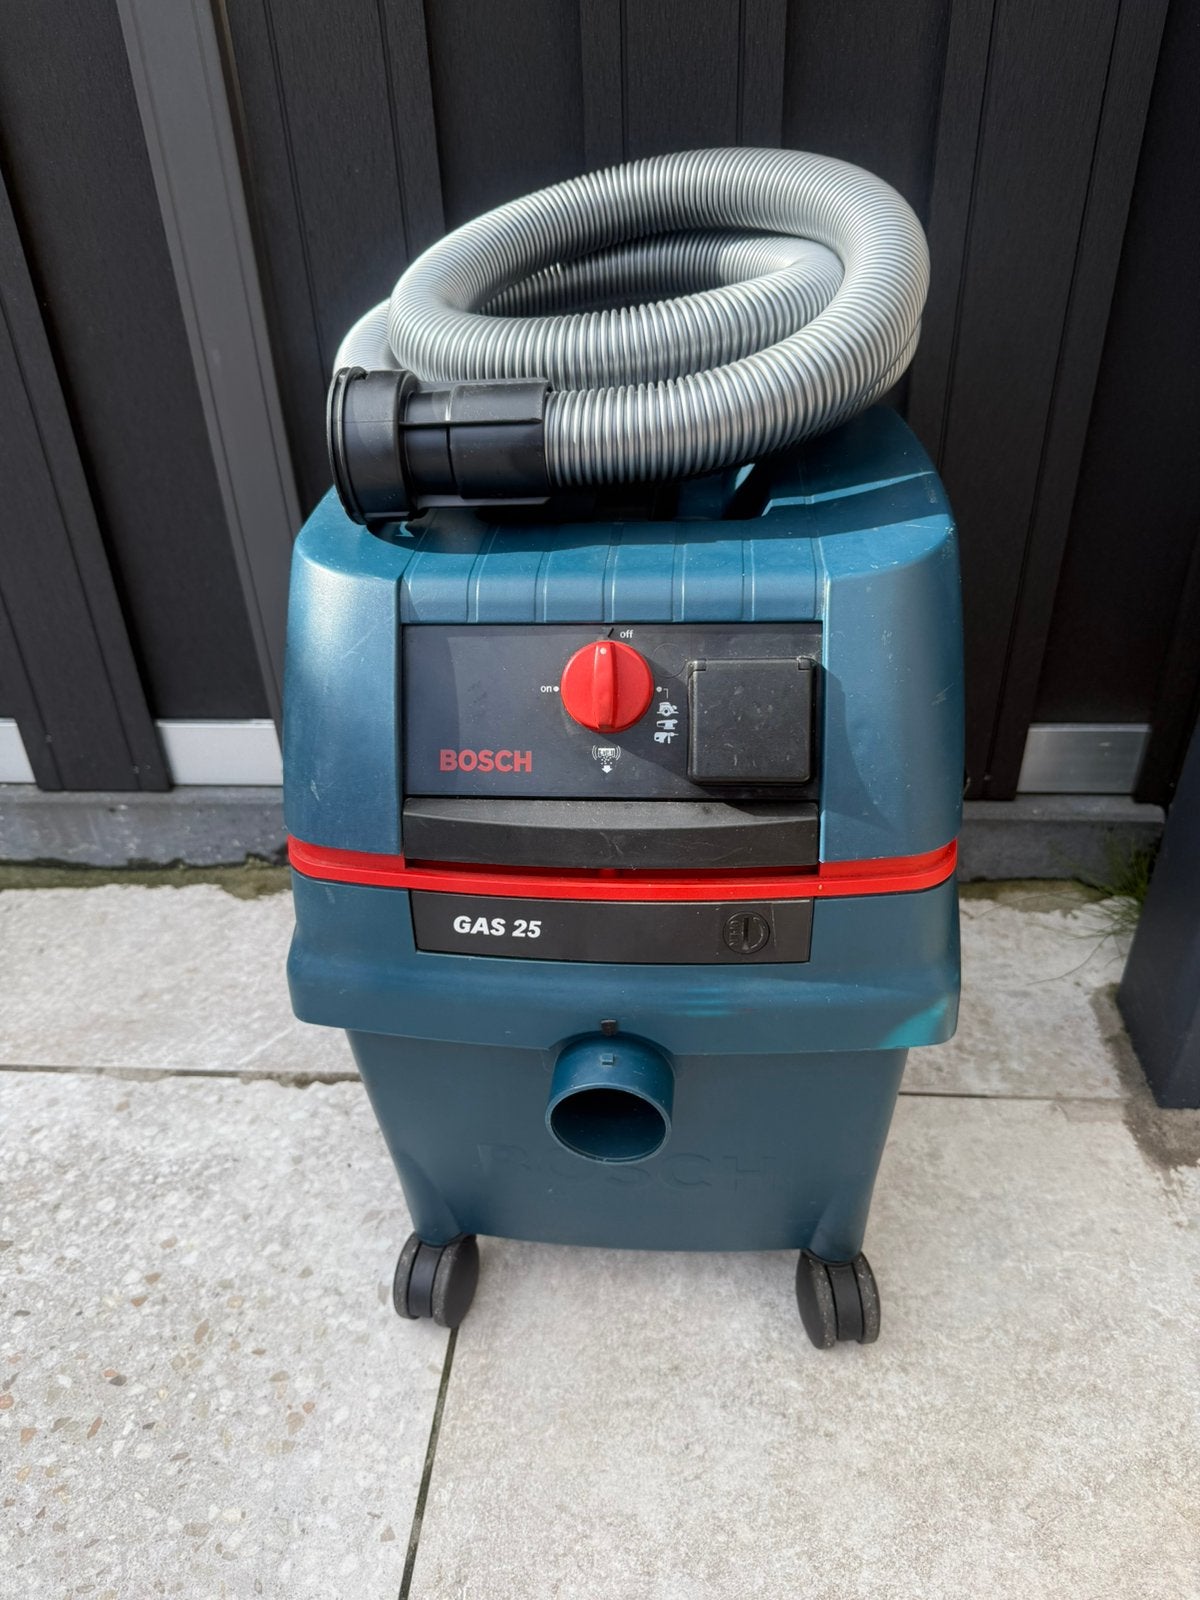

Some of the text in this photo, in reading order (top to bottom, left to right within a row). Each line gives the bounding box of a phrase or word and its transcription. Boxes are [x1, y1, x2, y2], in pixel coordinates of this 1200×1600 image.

[620, 629, 634, 639] off
[540, 685, 552, 693] on
[439, 749, 533, 773] BOSCH
[453, 915, 542, 938] GAS 25
